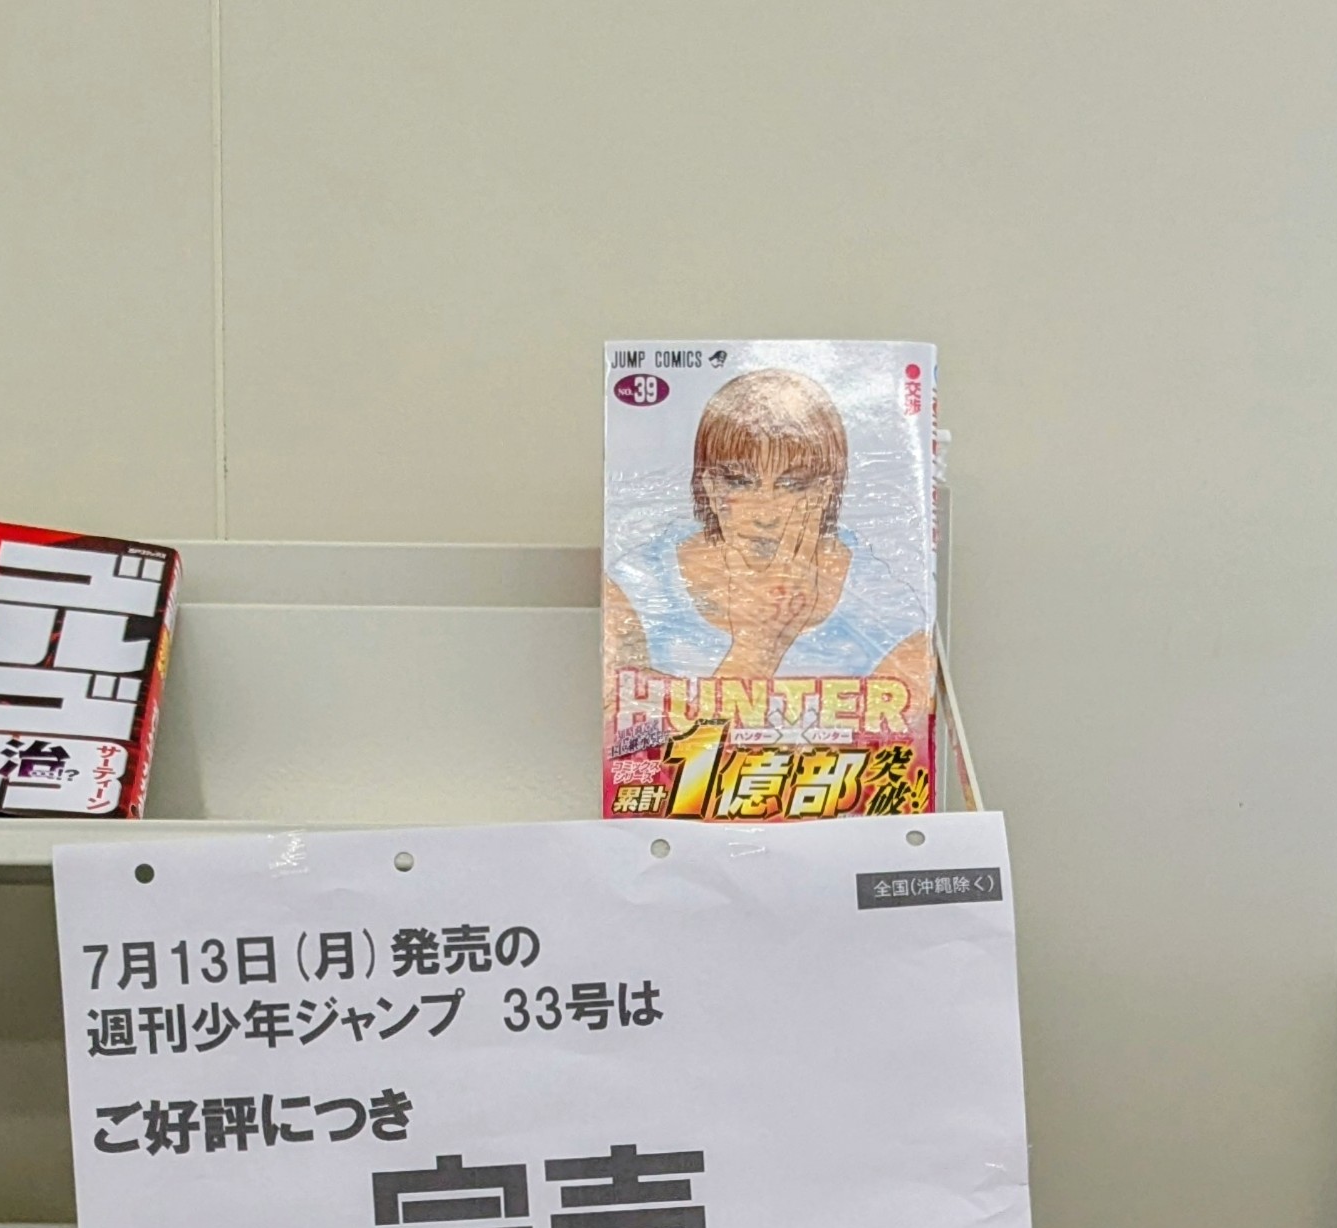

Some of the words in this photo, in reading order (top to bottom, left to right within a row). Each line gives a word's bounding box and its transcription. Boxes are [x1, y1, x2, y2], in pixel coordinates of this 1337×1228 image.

[611, 351, 645, 368] JUMP
[655, 350, 702, 368] COMICS
[614, 668, 912, 736] HUNTER
[86, 746, 122, 811] サーティーン
[613, 786, 667, 813] 累計
[664, 720, 869, 819] 1億部
[87, 995, 466, 1057] 週刊少年ジャンプ
[502, 980, 664, 1033] 33号は
[93, 1089, 414, 1156] ご好評につき
